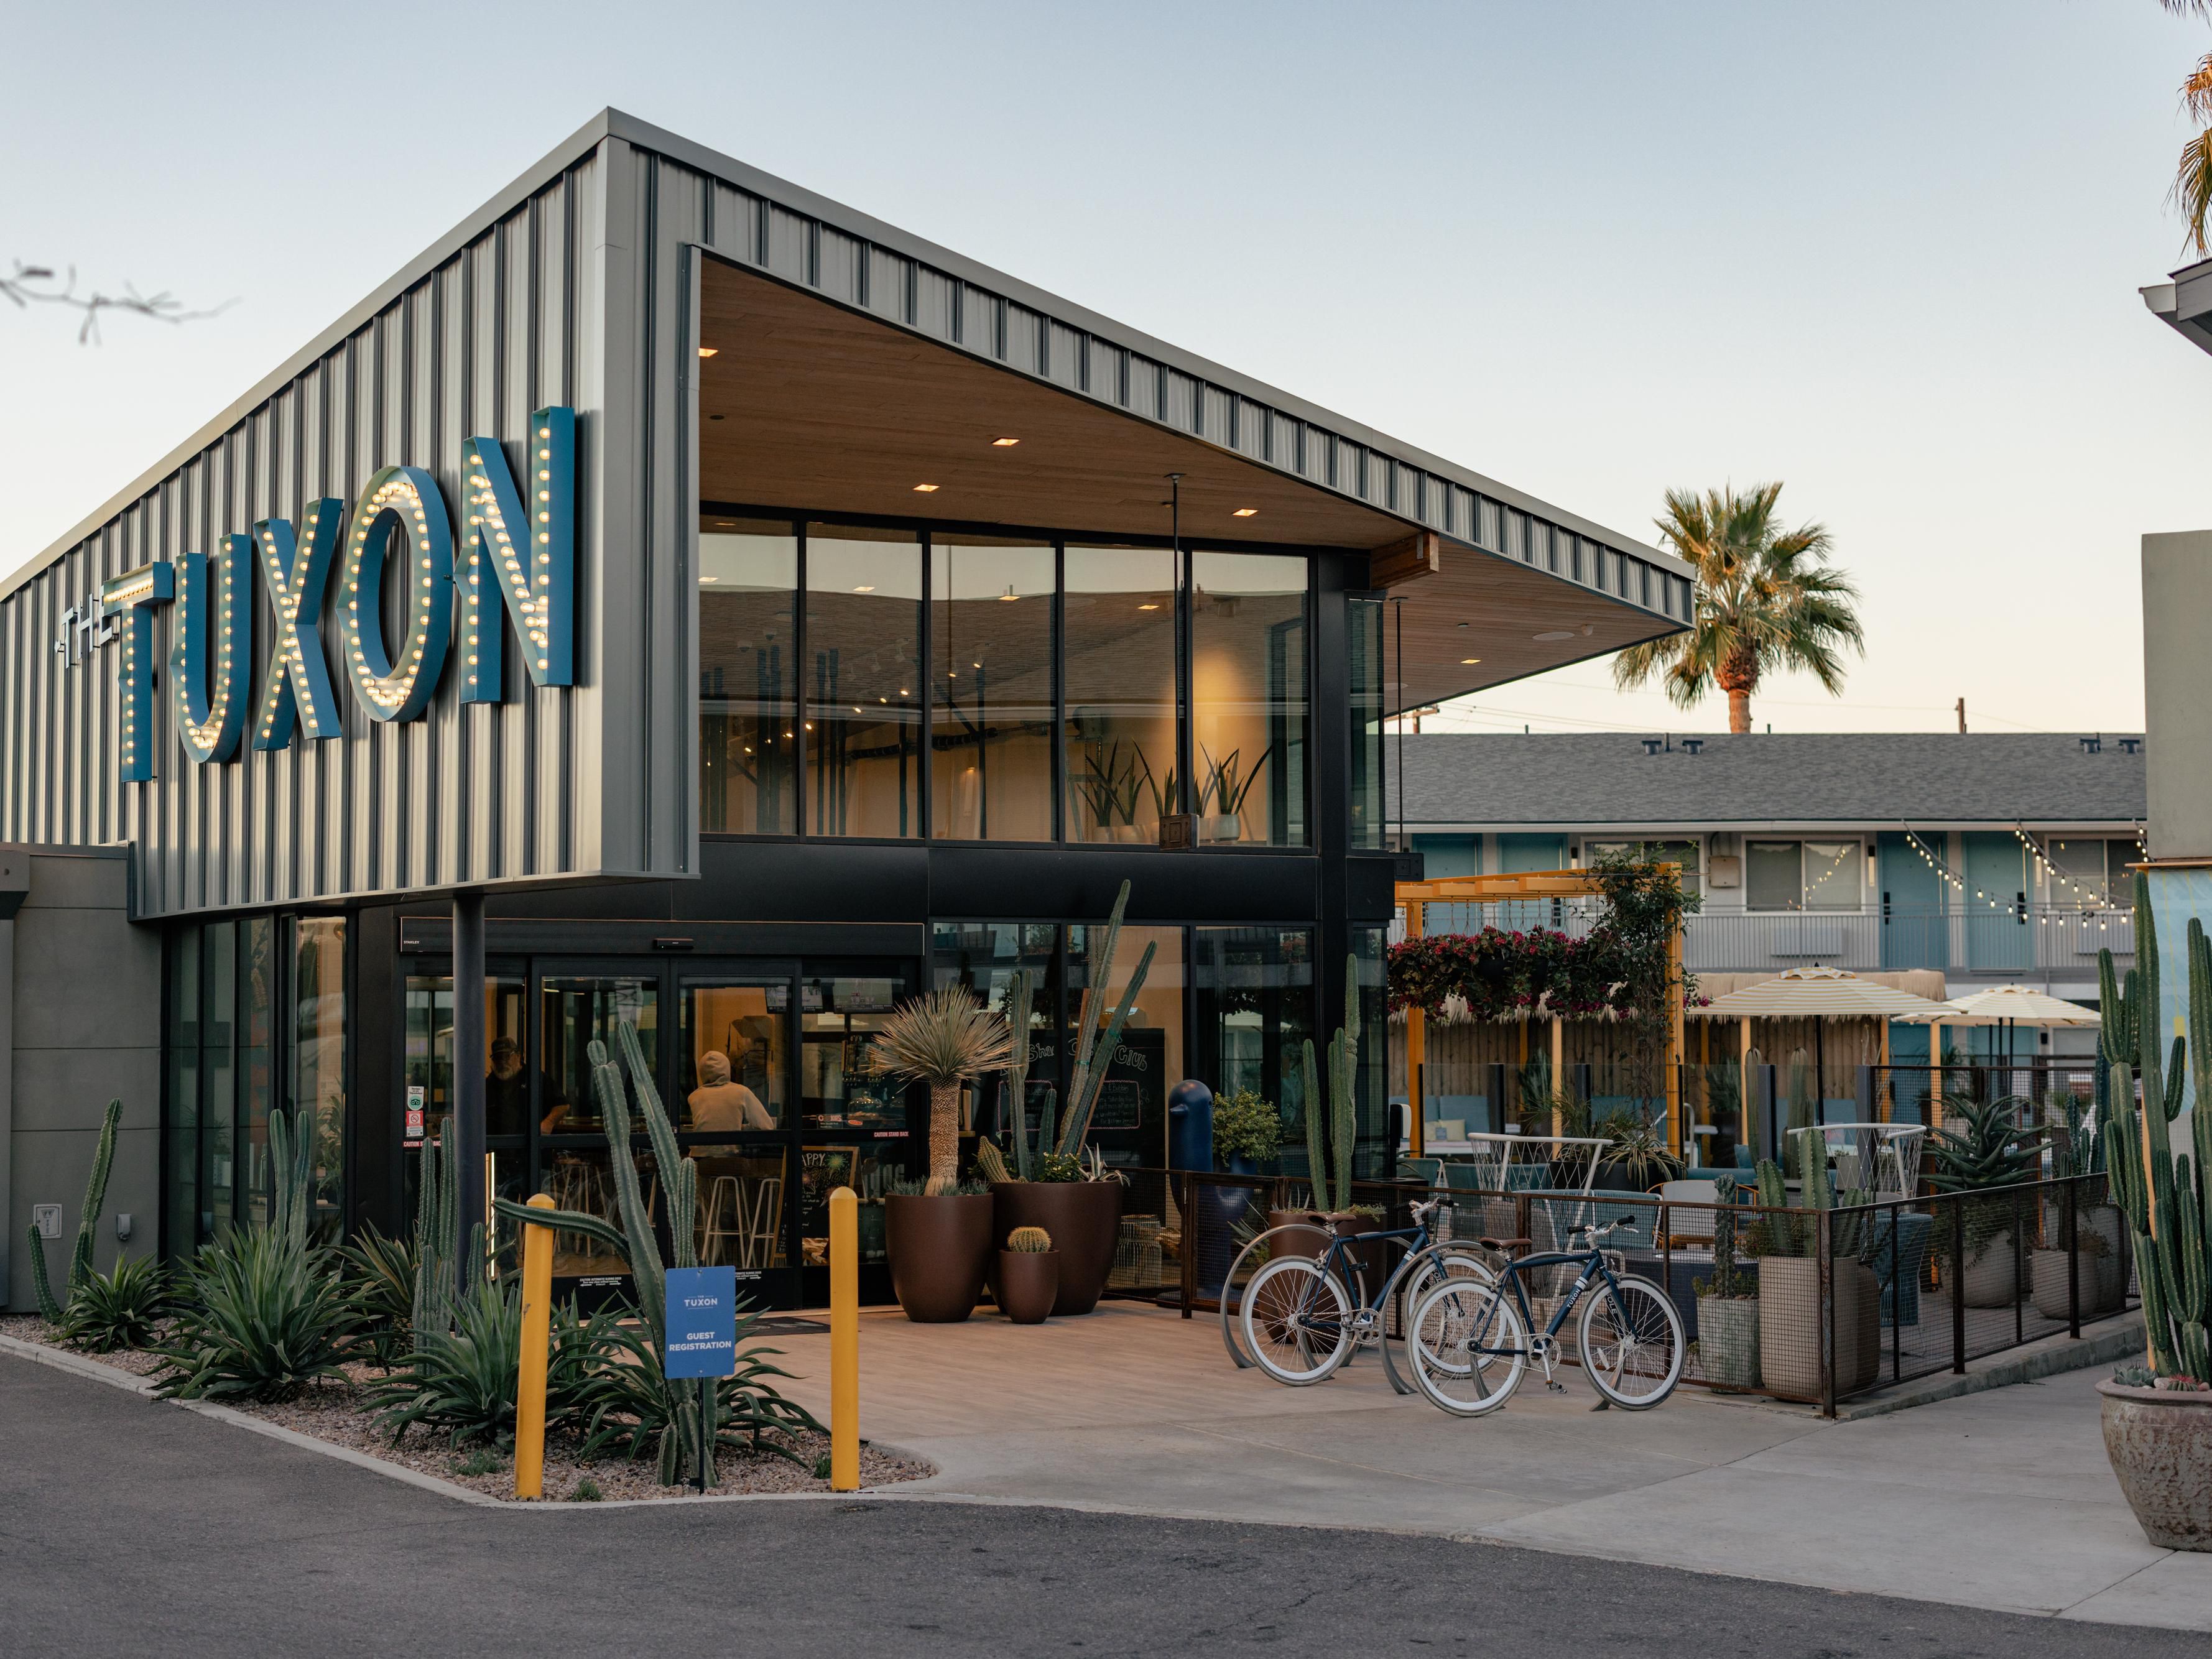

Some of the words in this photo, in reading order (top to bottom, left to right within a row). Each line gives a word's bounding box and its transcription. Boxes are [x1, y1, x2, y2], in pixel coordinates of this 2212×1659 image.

[61, 585, 113, 669] THE
[103, 405, 575, 783] TUXON
[1029, 1043, 1055, 1062] Sha
[802, 1153, 826, 1167] APPY
[684, 1298, 718, 1307] TUXON
[1566, 1288, 1581, 1308] TUXON
[687, 1331, 715, 1340] GUEST
[669, 1341, 731, 1352] REGISTRATION
